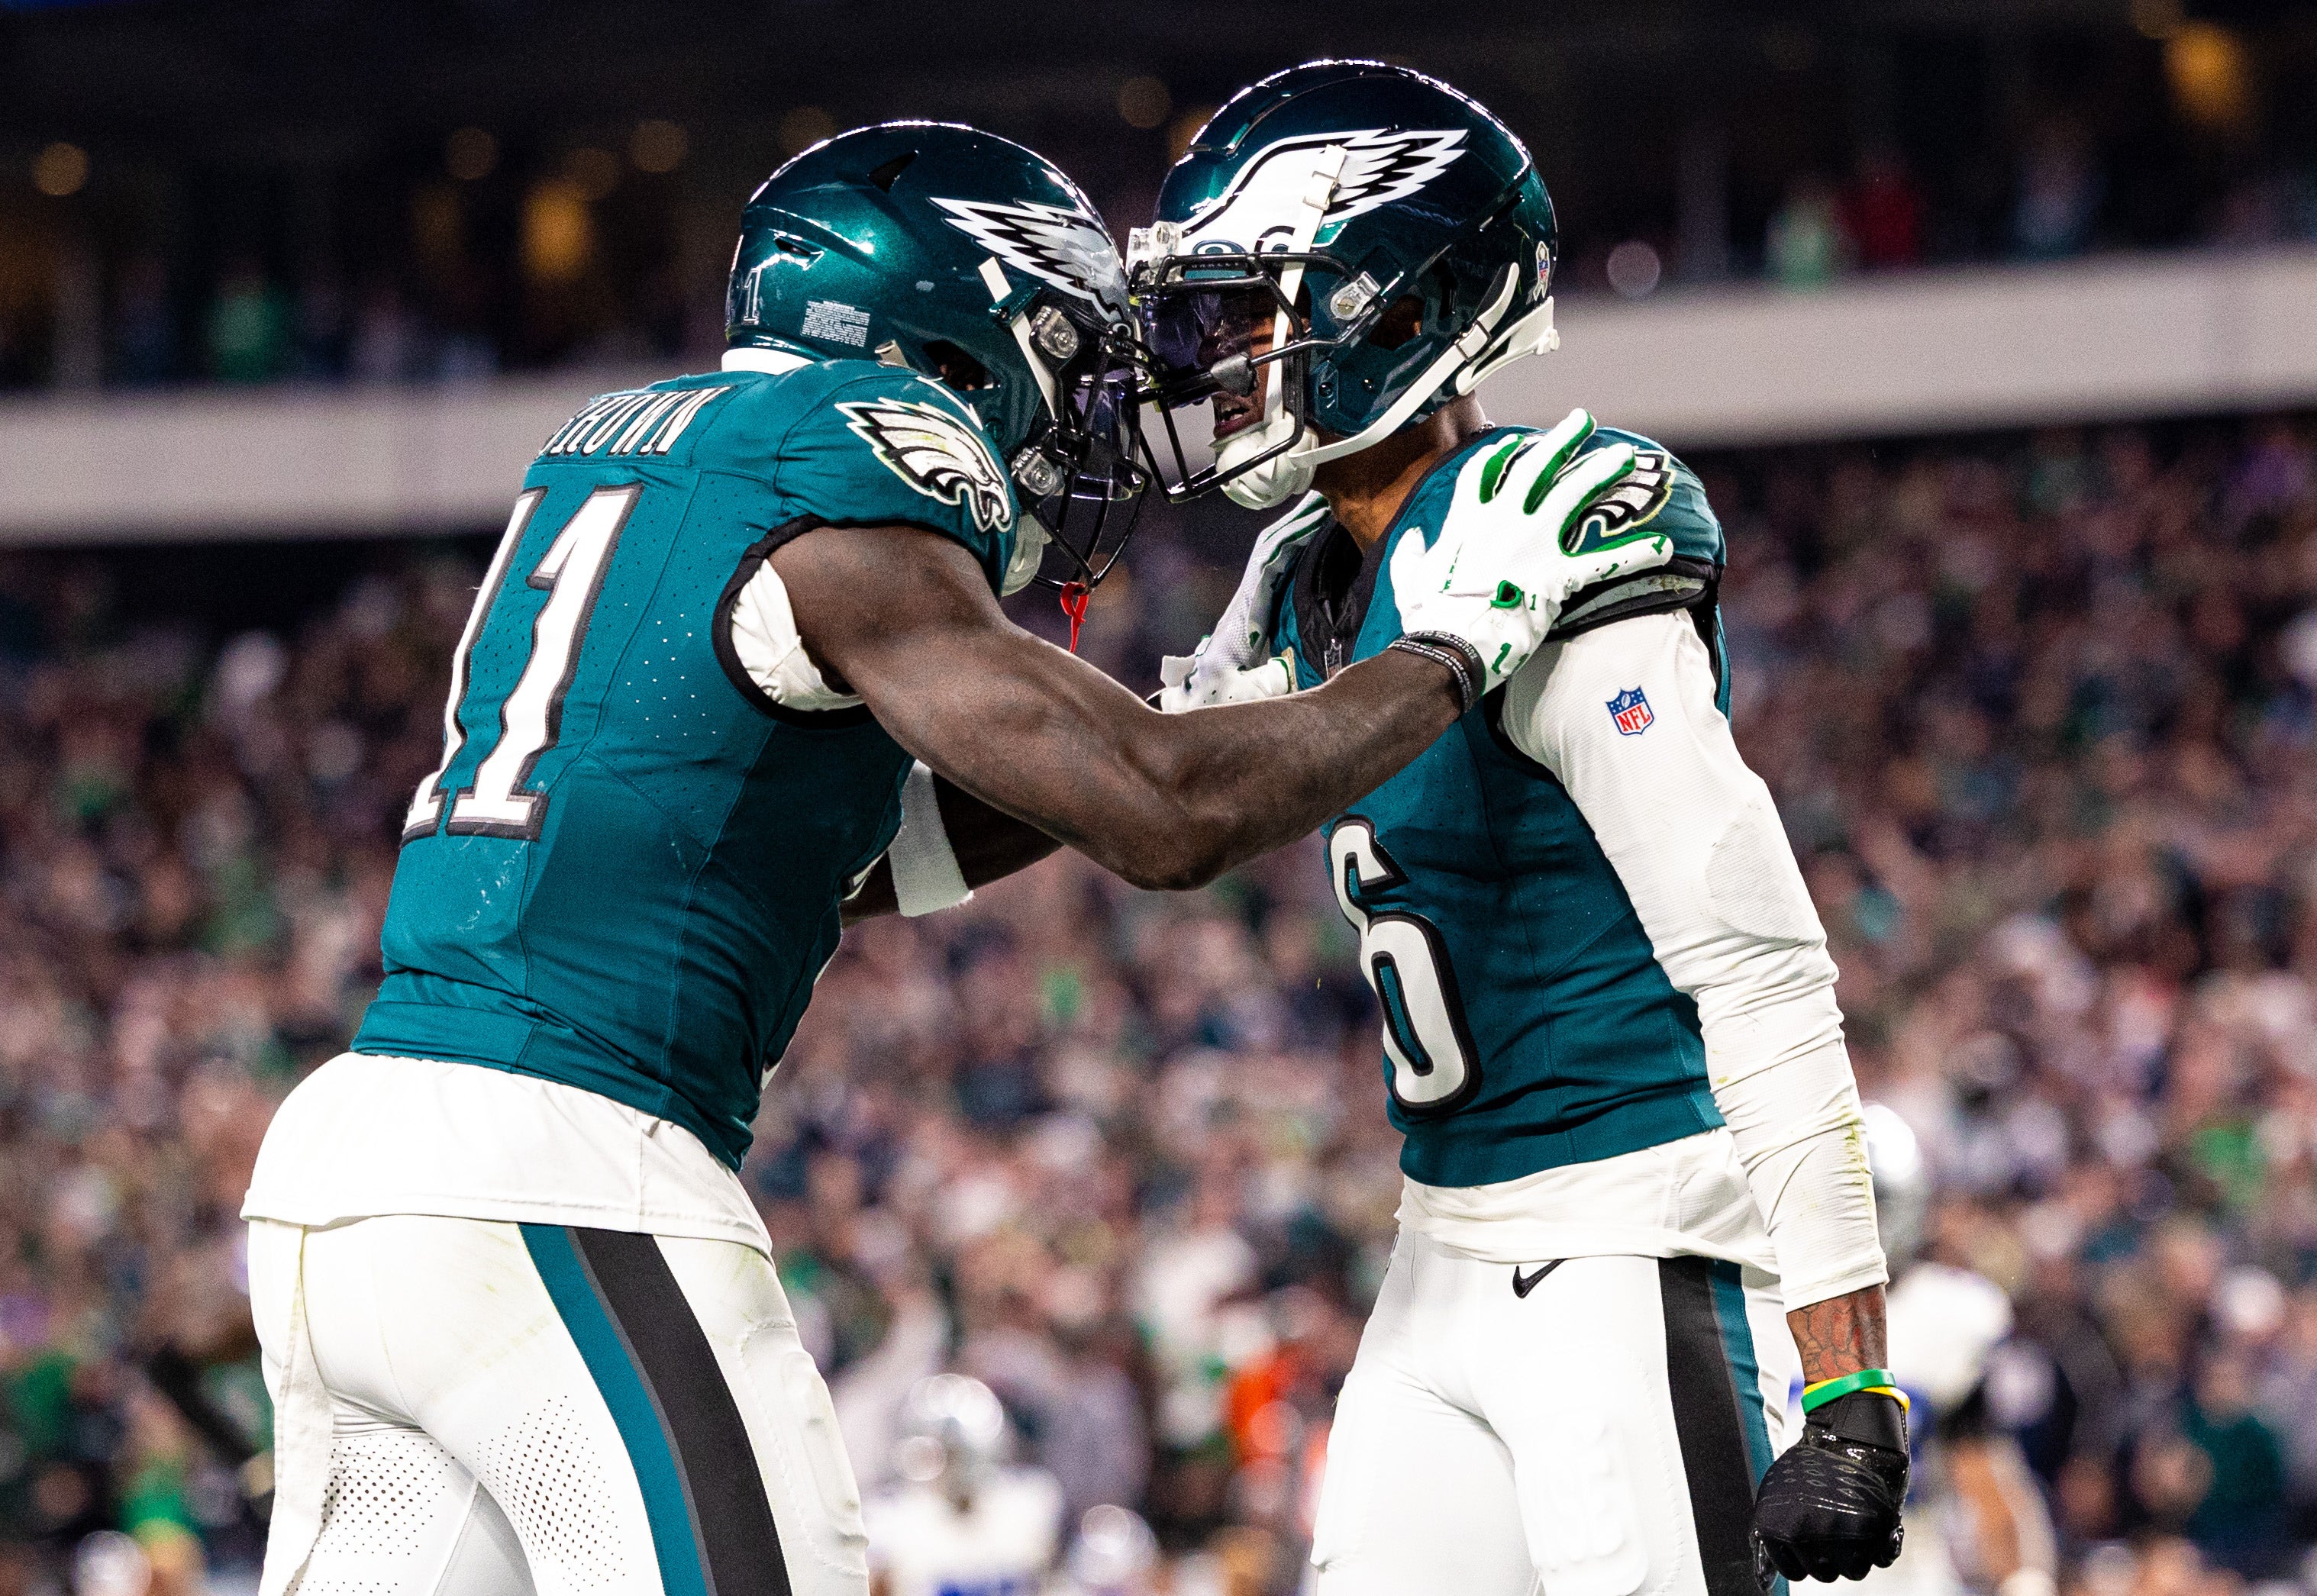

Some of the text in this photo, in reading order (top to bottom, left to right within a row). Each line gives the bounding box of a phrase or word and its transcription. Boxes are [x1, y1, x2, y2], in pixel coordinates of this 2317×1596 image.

[400, 482, 644, 846] 11
[1616, 704, 1651, 732] NFL
[1328, 814, 1483, 1116] 6
